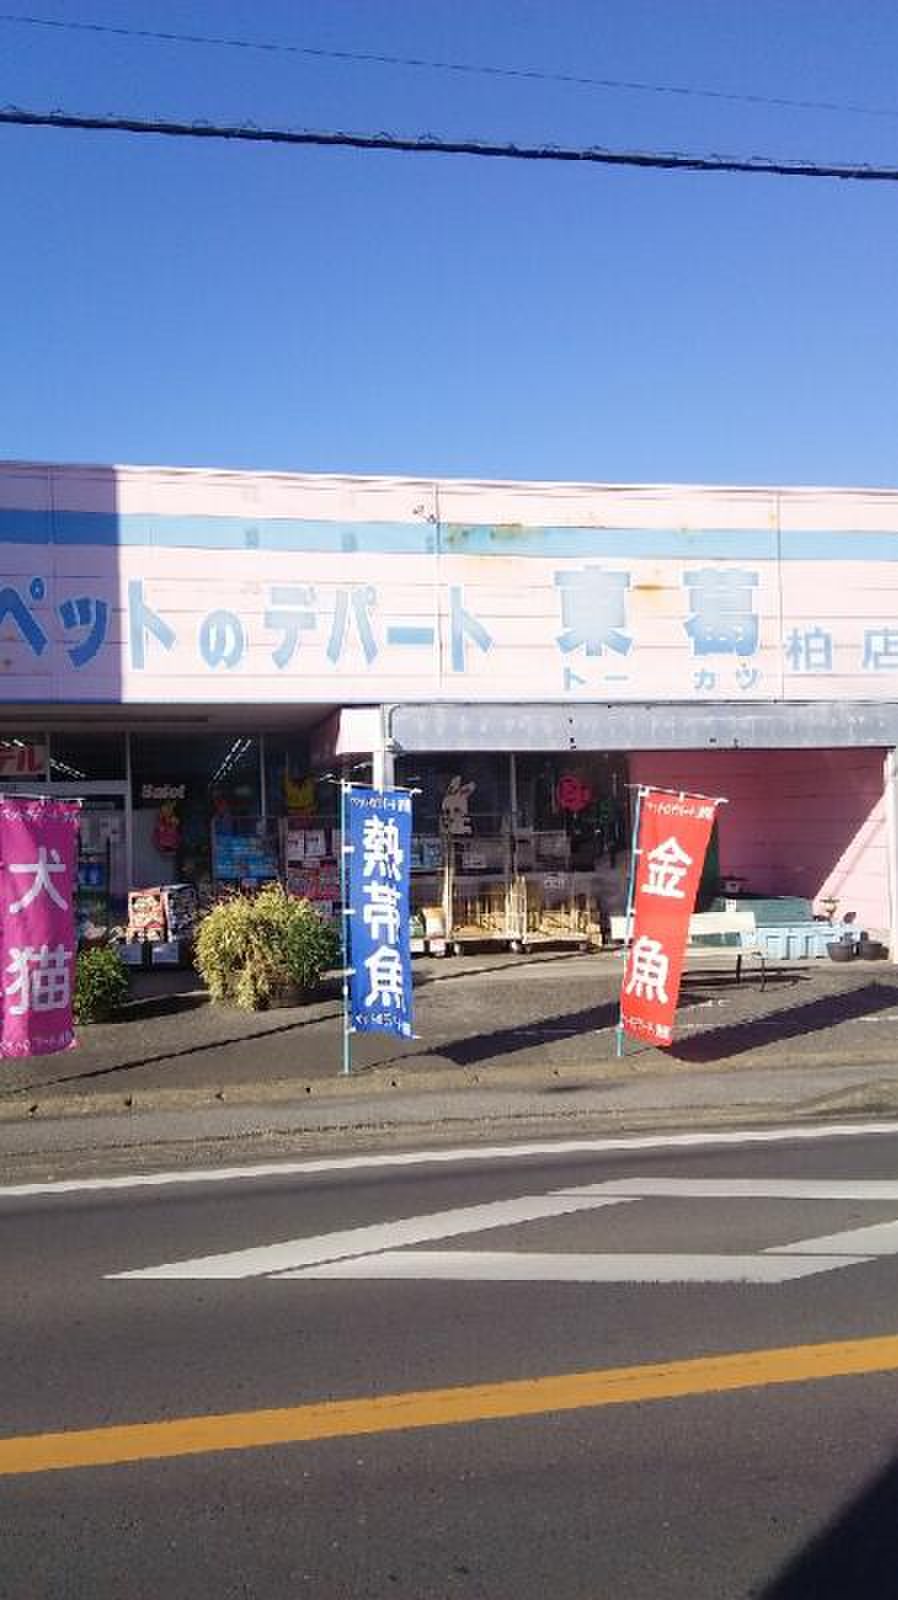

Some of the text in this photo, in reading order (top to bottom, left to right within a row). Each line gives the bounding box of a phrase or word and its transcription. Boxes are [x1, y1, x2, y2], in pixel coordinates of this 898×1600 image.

[0, 575, 494, 673] ペットのデパート
[785, 625, 898, 672] 柏店
[362, 815, 407, 1014] 熱帯魚
[624, 835, 693, 1005] 金魚
